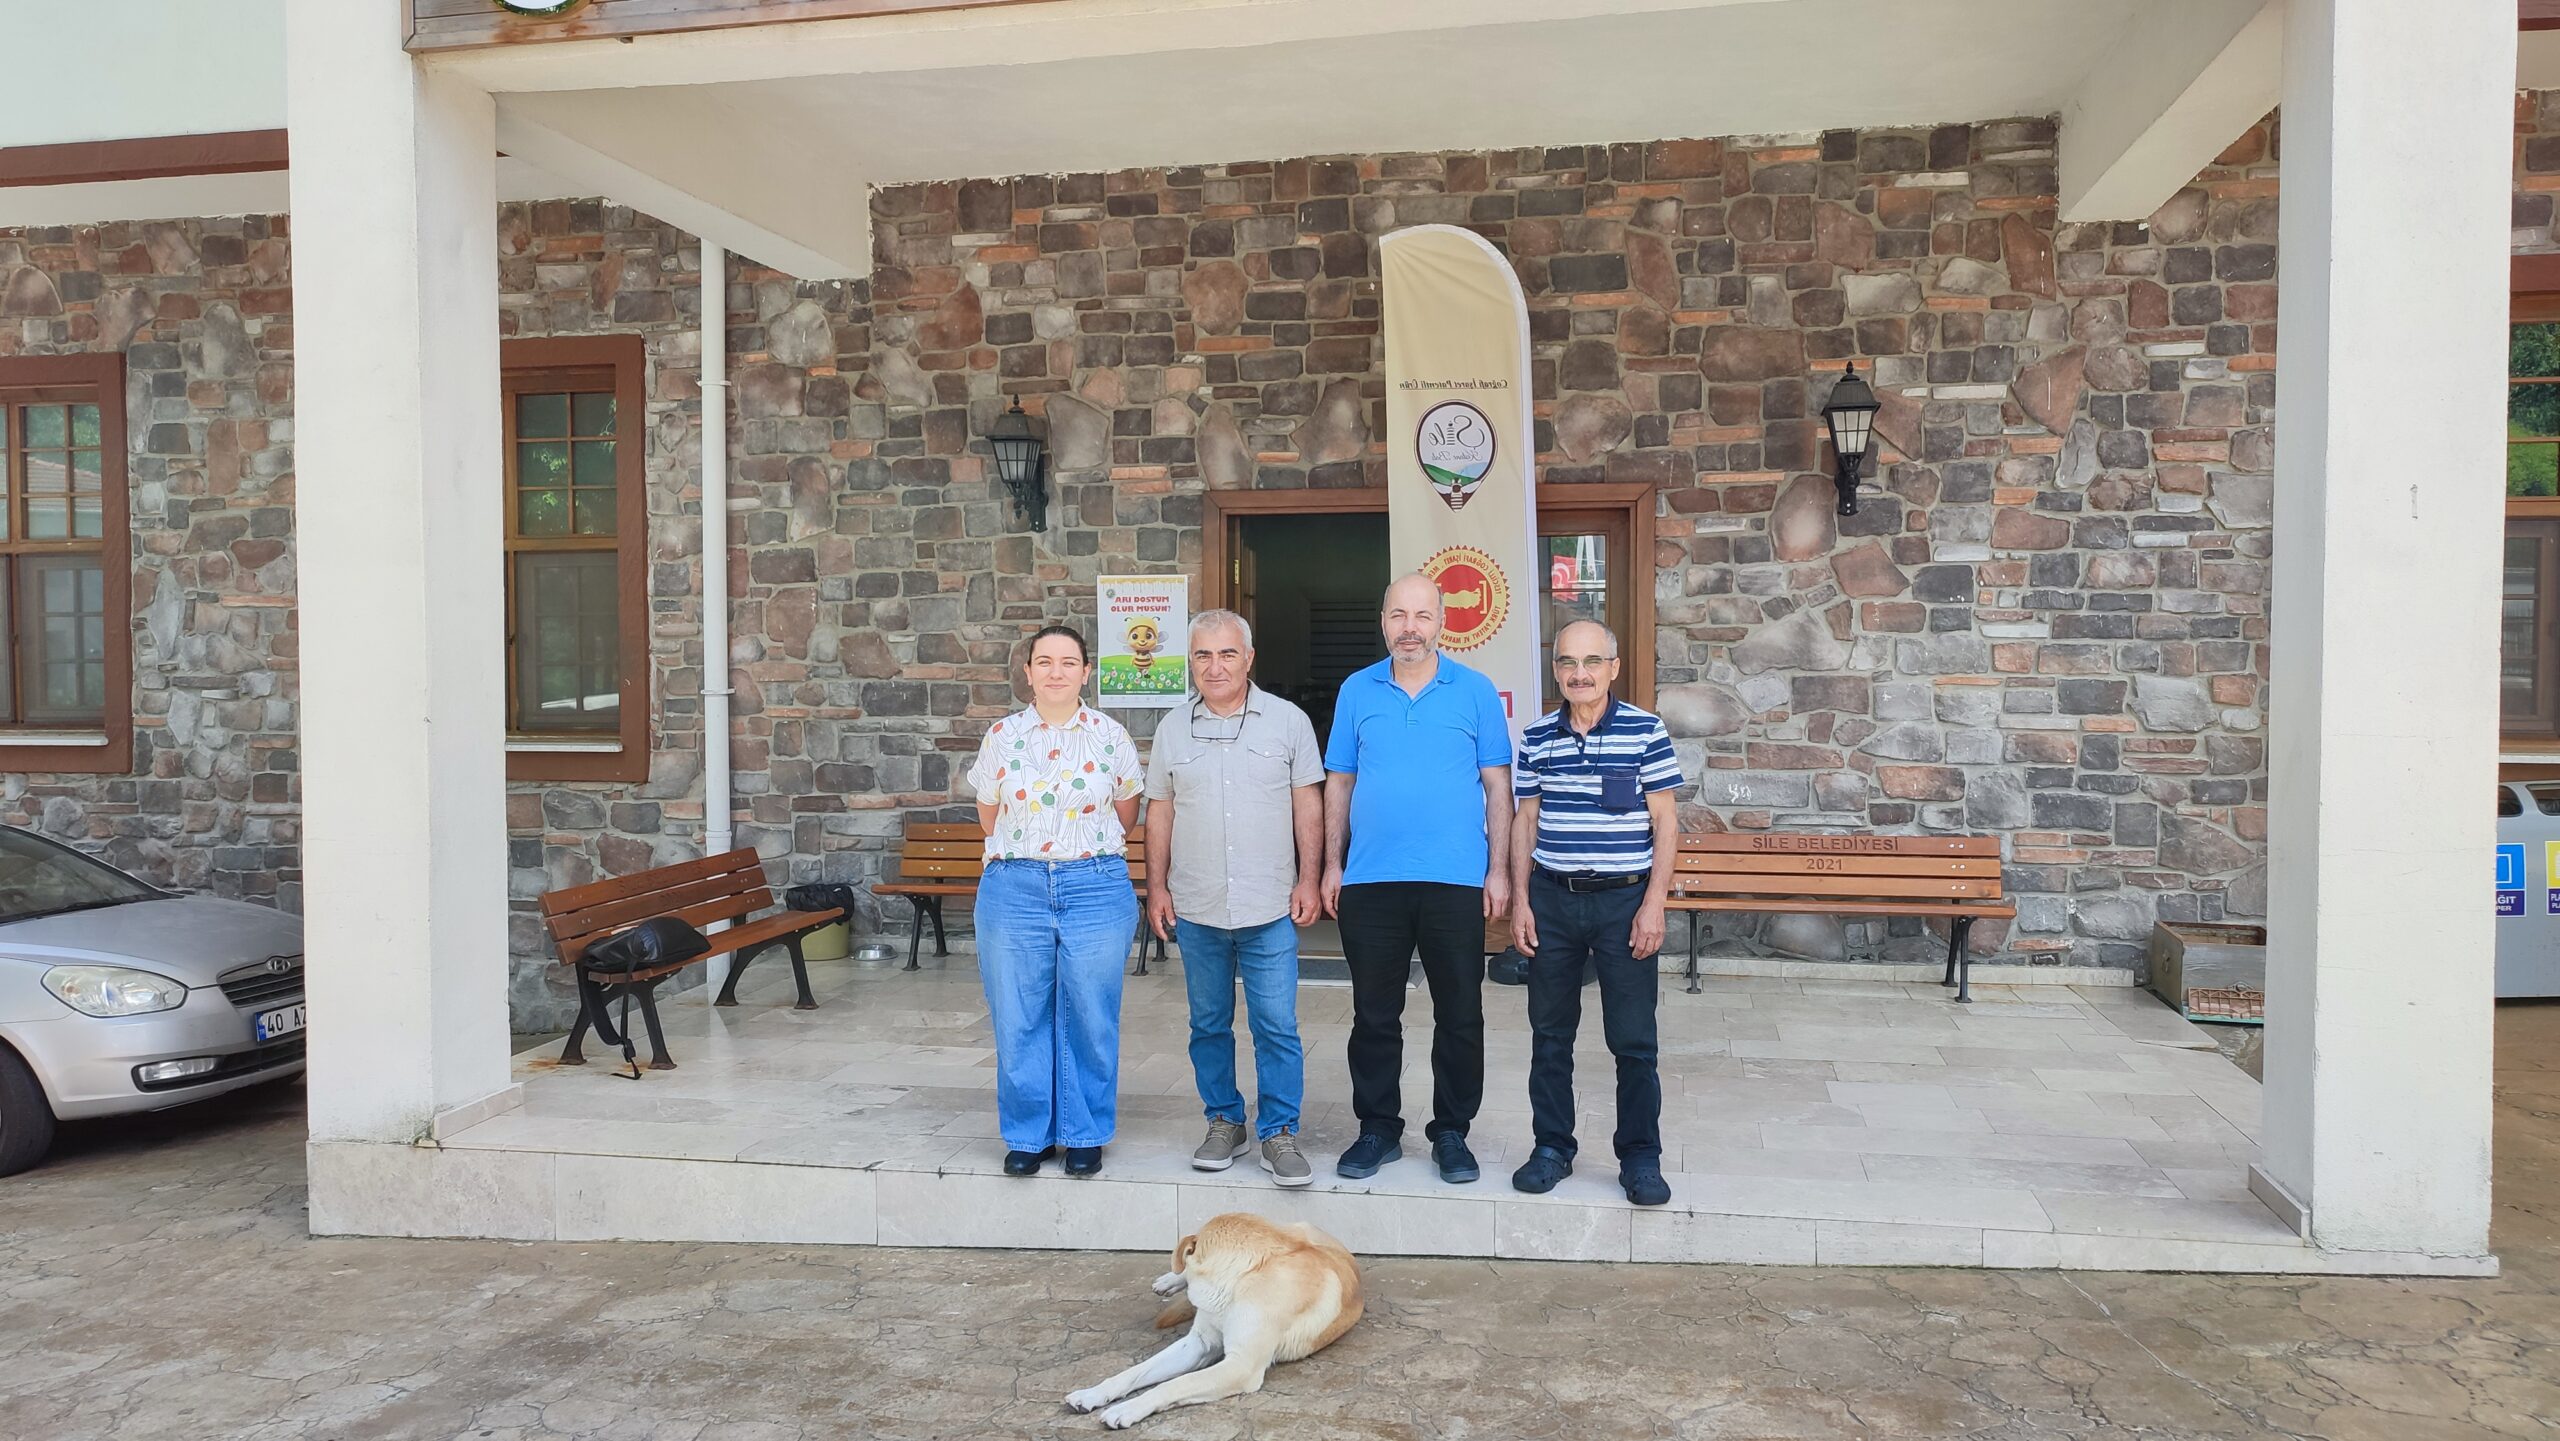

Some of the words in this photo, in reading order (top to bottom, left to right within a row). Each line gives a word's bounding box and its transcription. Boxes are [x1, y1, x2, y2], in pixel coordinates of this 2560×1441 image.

[1752, 834, 1789, 851] ŞİLE
[1798, 836, 1899, 851] BELEDİYESİ
[1806, 858, 1843, 870] 2021
[2496, 894, 2517, 904] ĞIT
[267, 1013, 284, 1034] 40
